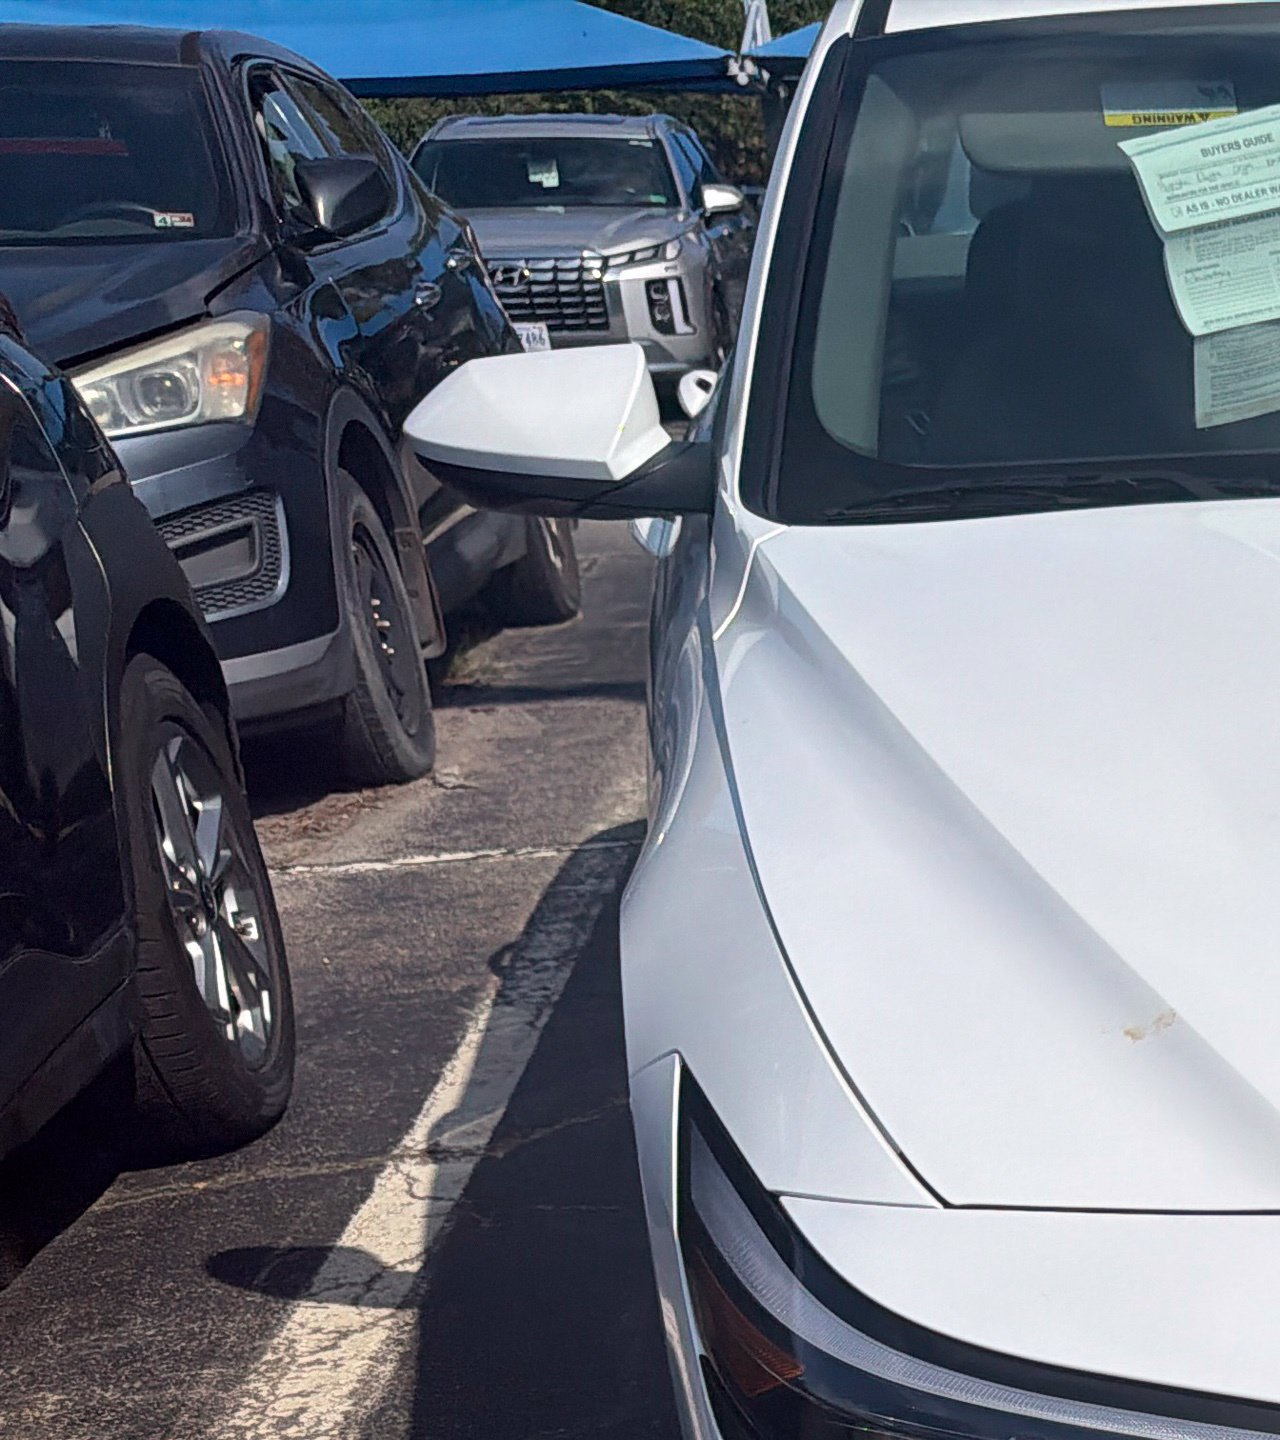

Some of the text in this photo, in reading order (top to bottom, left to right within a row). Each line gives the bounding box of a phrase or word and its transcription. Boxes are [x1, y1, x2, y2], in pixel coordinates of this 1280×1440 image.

[1200, 133, 1275, 158] BUYERS GUIDE
[1185, 204, 1198, 215] AS
[1200, 201, 1210, 211] IS
[1216, 196, 1230, 206] NO
[1231, 187, 1268, 203] DEALER
